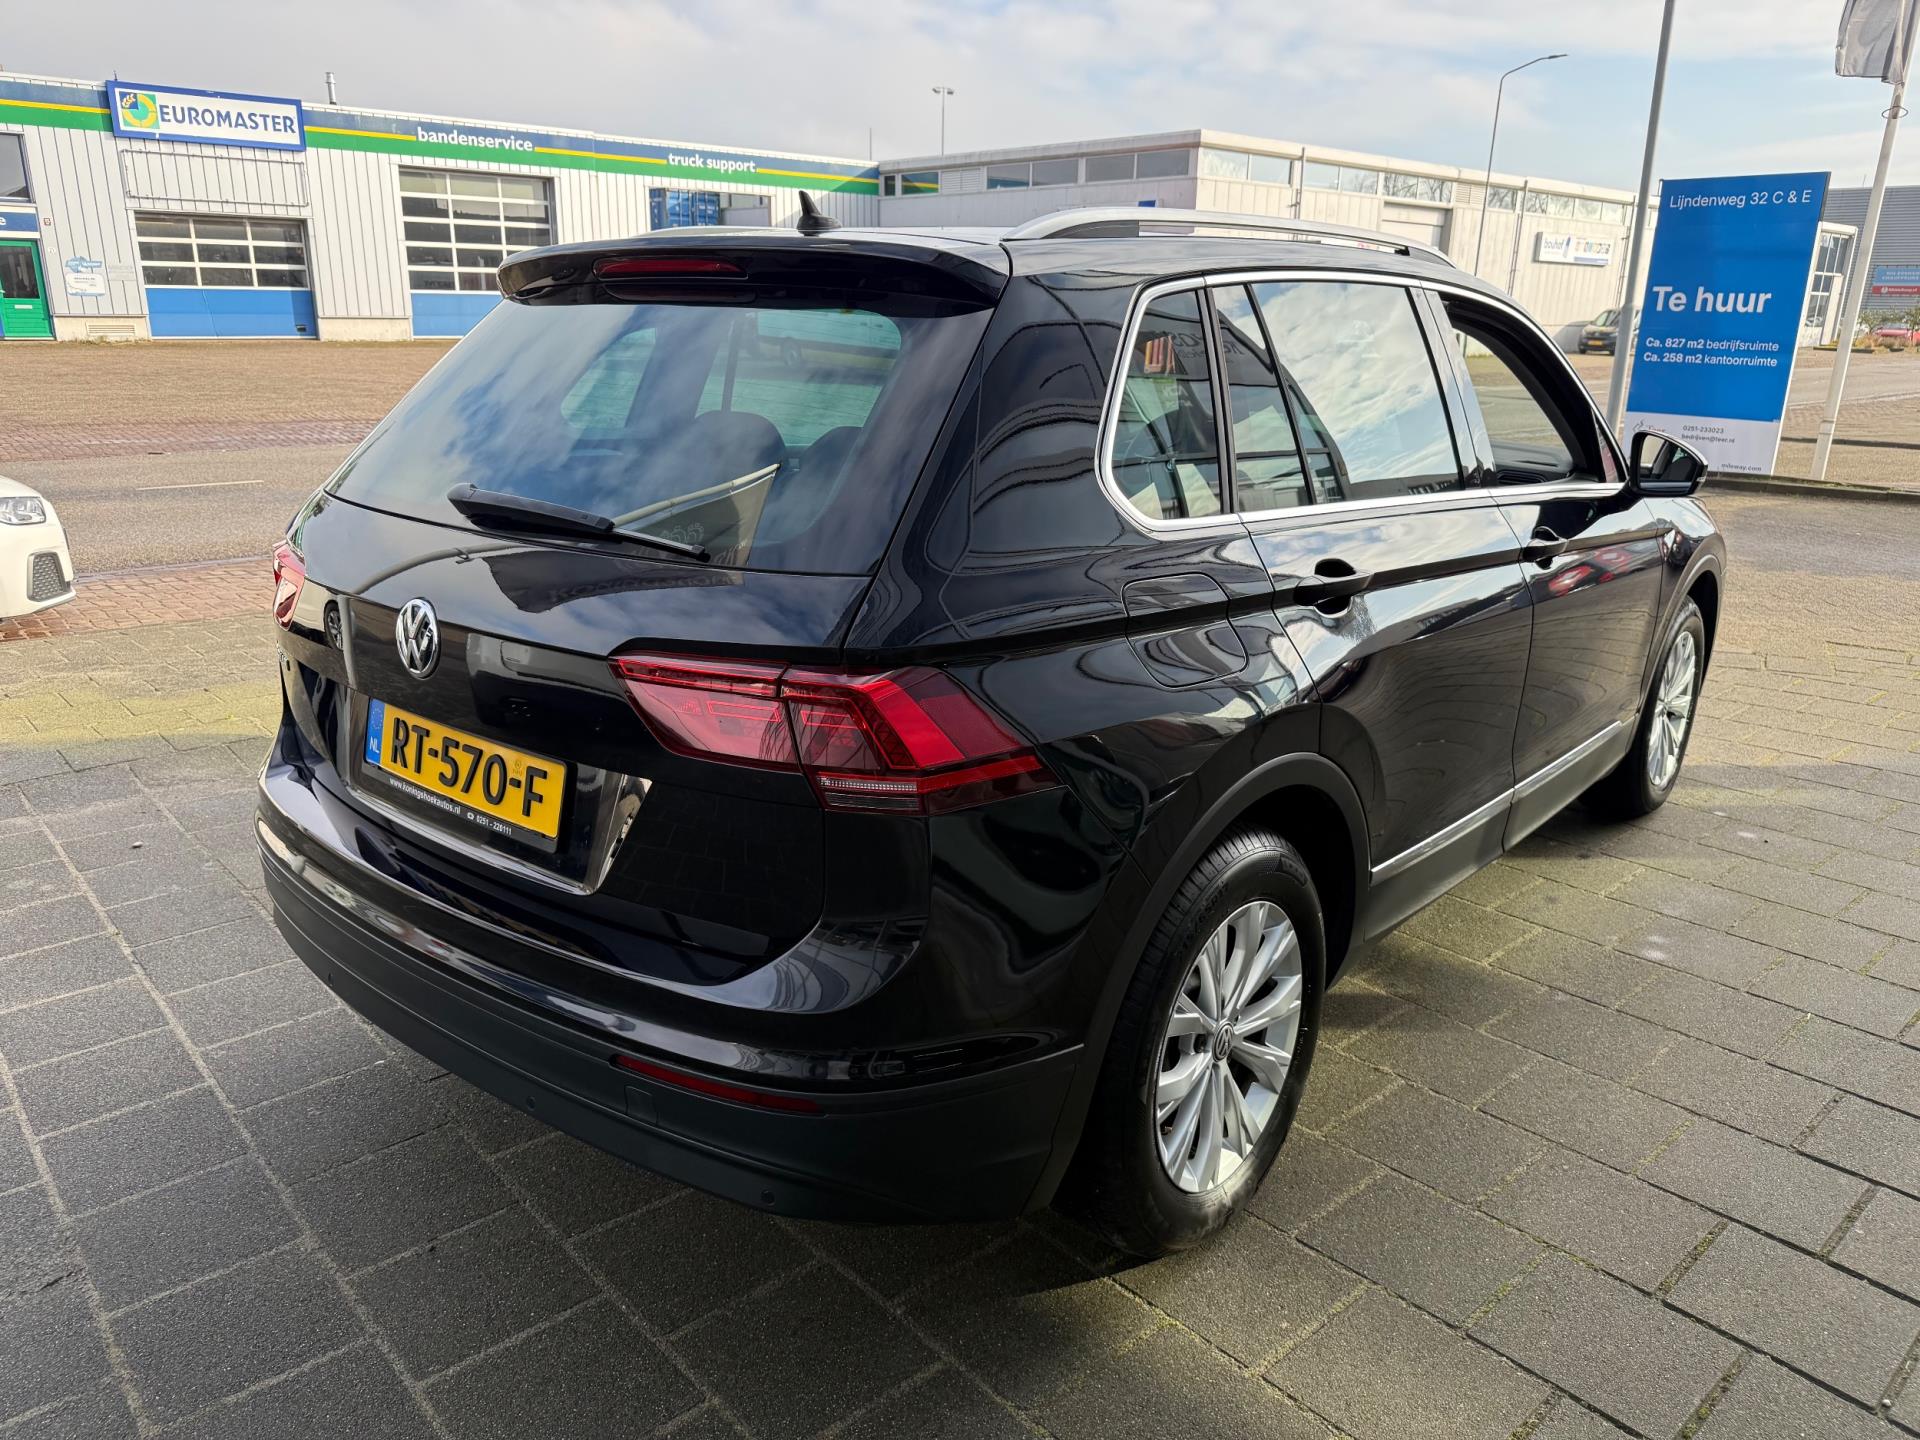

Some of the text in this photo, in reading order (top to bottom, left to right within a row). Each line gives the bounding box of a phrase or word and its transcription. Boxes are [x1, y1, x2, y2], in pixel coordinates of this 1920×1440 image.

[159, 104, 296, 134] EUROMASTER
[416, 127, 534, 152] bandenservice
[668, 152, 757, 175] truck support
[1670, 189, 1812, 209] Lijndenweg 32 C & E
[1652, 286, 1772, 314] Te huur
[1645, 337, 1779, 352] Ca. 827 m2 bedrijfsruimte
[1643, 352, 1778, 367] Ca. 258 m2 kantoorruimte
[369, 736, 380, 754] NL
[390, 716, 548, 817] RT-570-F
[389, 777, 461, 815] www.koningshoekautos.nl
